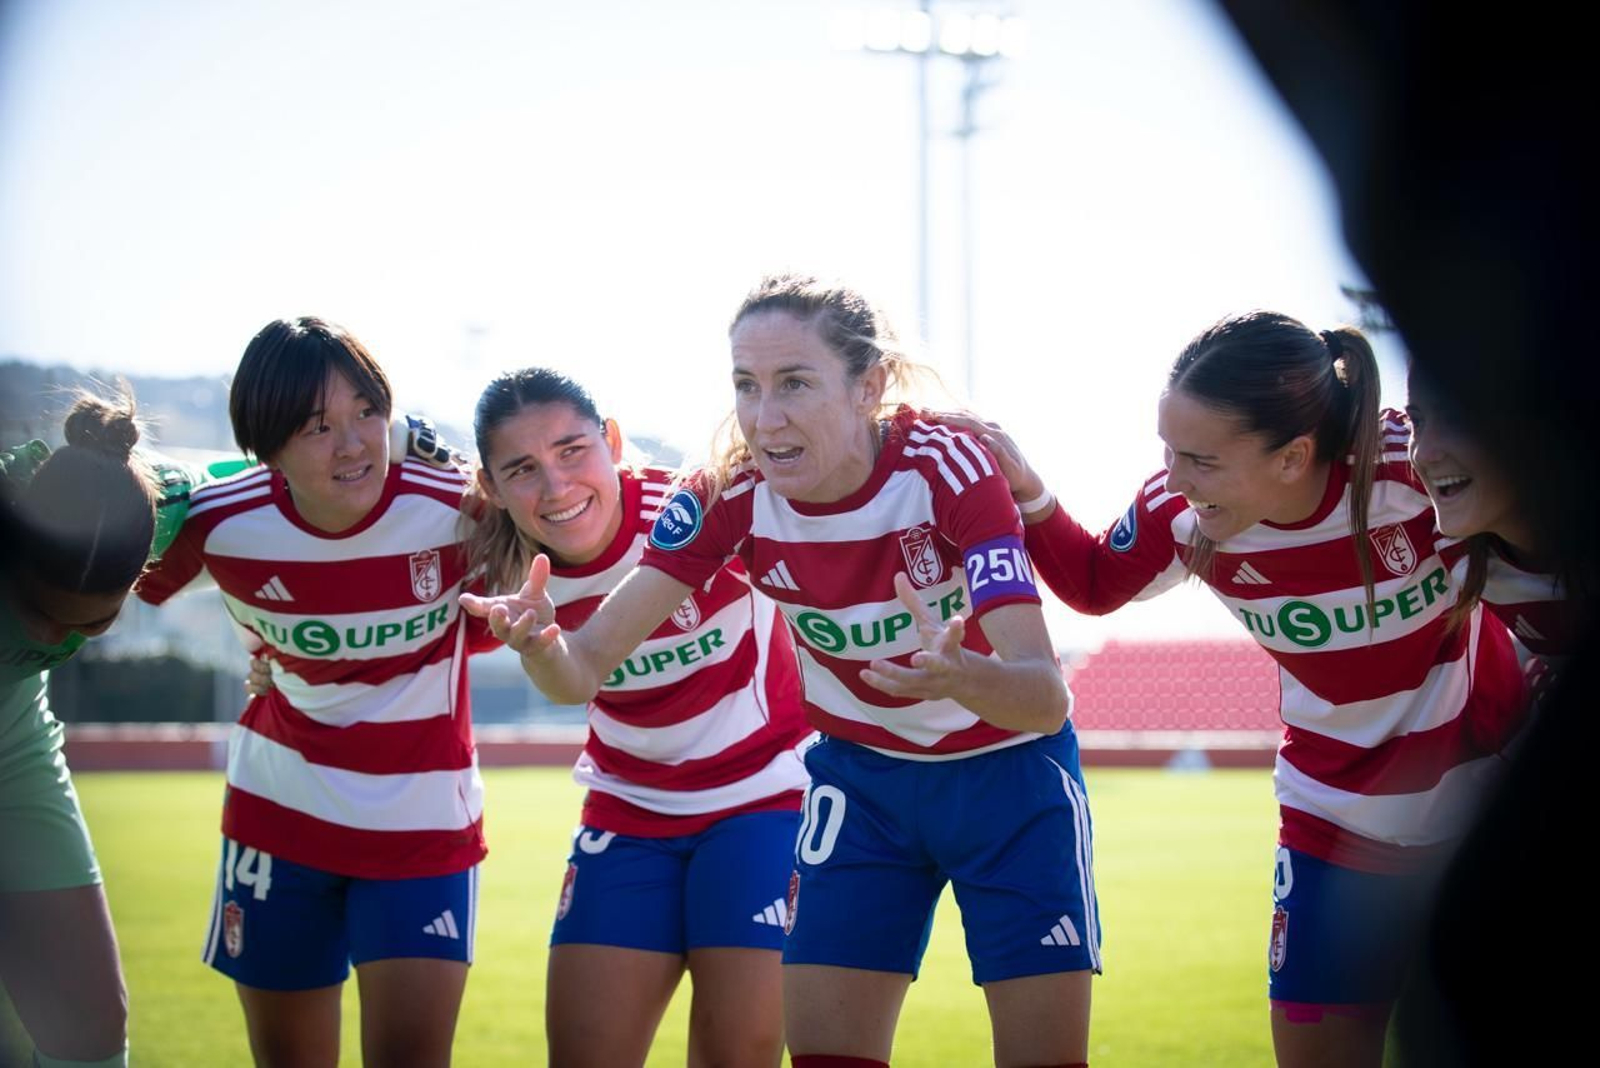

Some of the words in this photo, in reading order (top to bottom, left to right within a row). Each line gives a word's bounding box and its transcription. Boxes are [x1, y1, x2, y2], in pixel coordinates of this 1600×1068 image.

[292, 603, 449, 656] SUPER
[797, 586, 966, 652] SUPR
[1277, 567, 1449, 648] SUPER
[225, 838, 272, 901] 14
